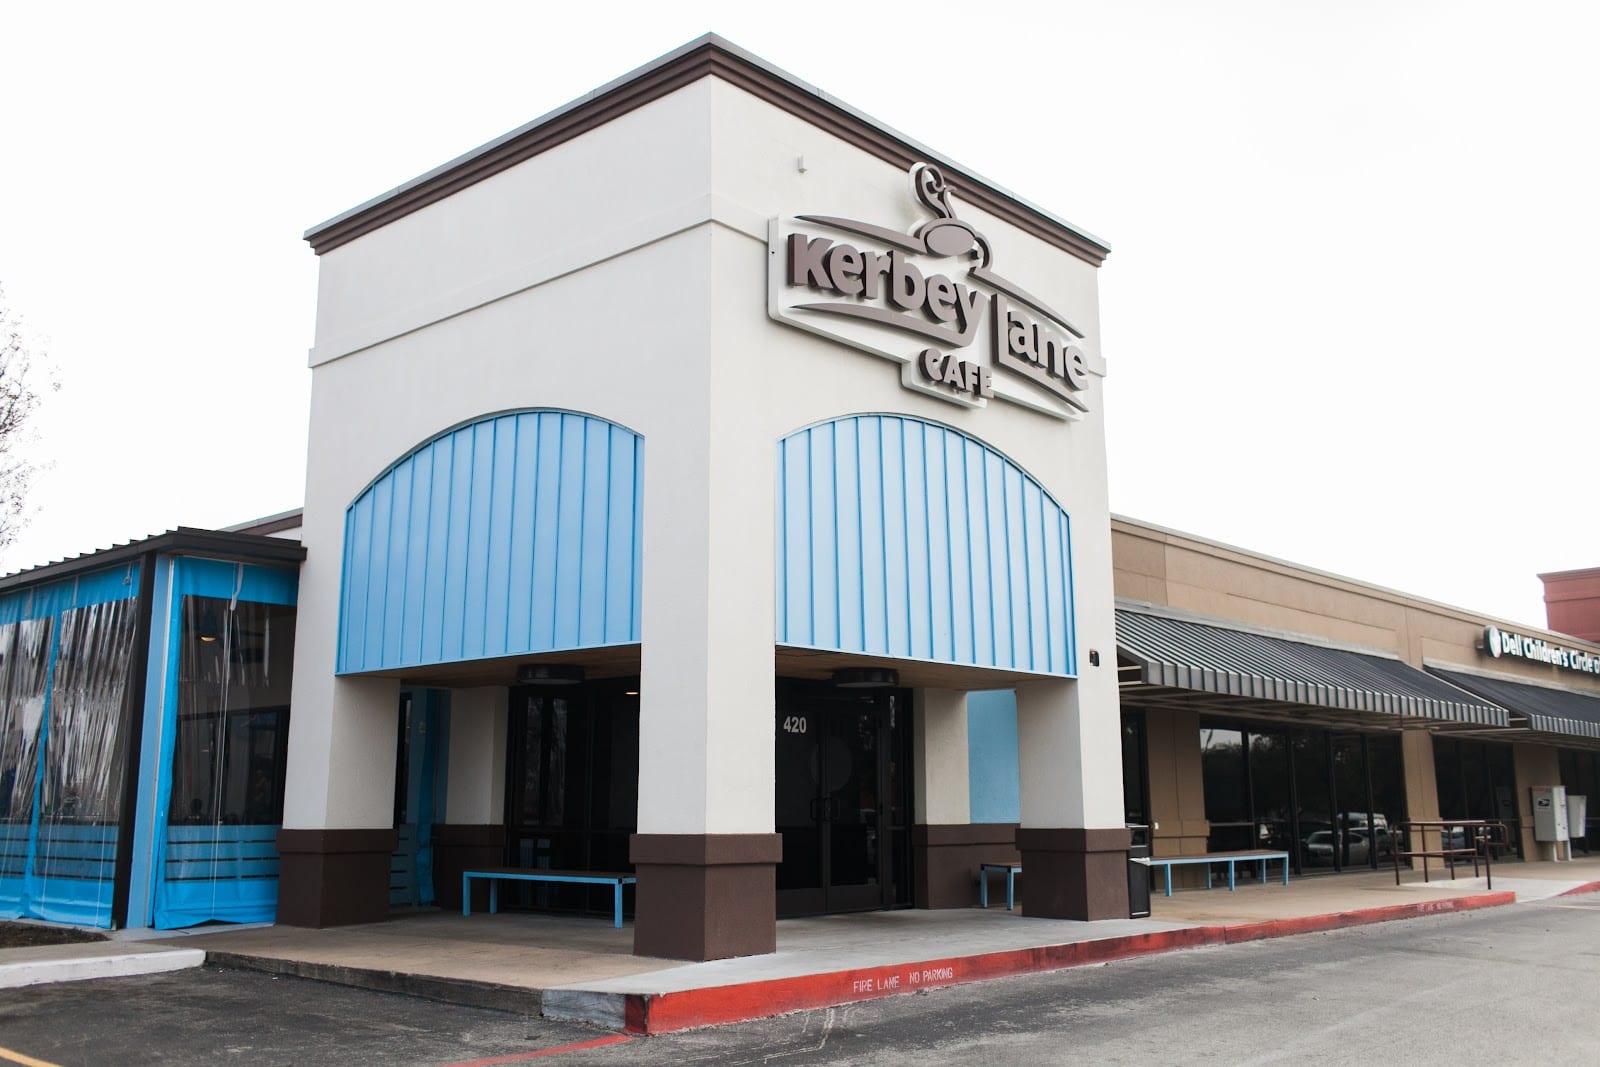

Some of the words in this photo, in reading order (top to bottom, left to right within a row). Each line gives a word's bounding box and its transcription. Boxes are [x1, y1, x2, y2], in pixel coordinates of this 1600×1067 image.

[787, 232, 988, 348] Kerbey
[991, 292, 1089, 411] Lane
[918, 348, 995, 399] CAFE
[1501, 631, 1524, 657] Dell
[1523, 637, 1569, 668] Children's
[1569, 649, 1593, 673] Circle
[1594, 656, 1600, 674] o
[783, 715, 807, 734] 420
[853, 978, 873, 993] FIRE
[877, 975, 900, 990] LANE
[909, 971, 920, 985] NO
[922, 967, 953, 982] PARKING
